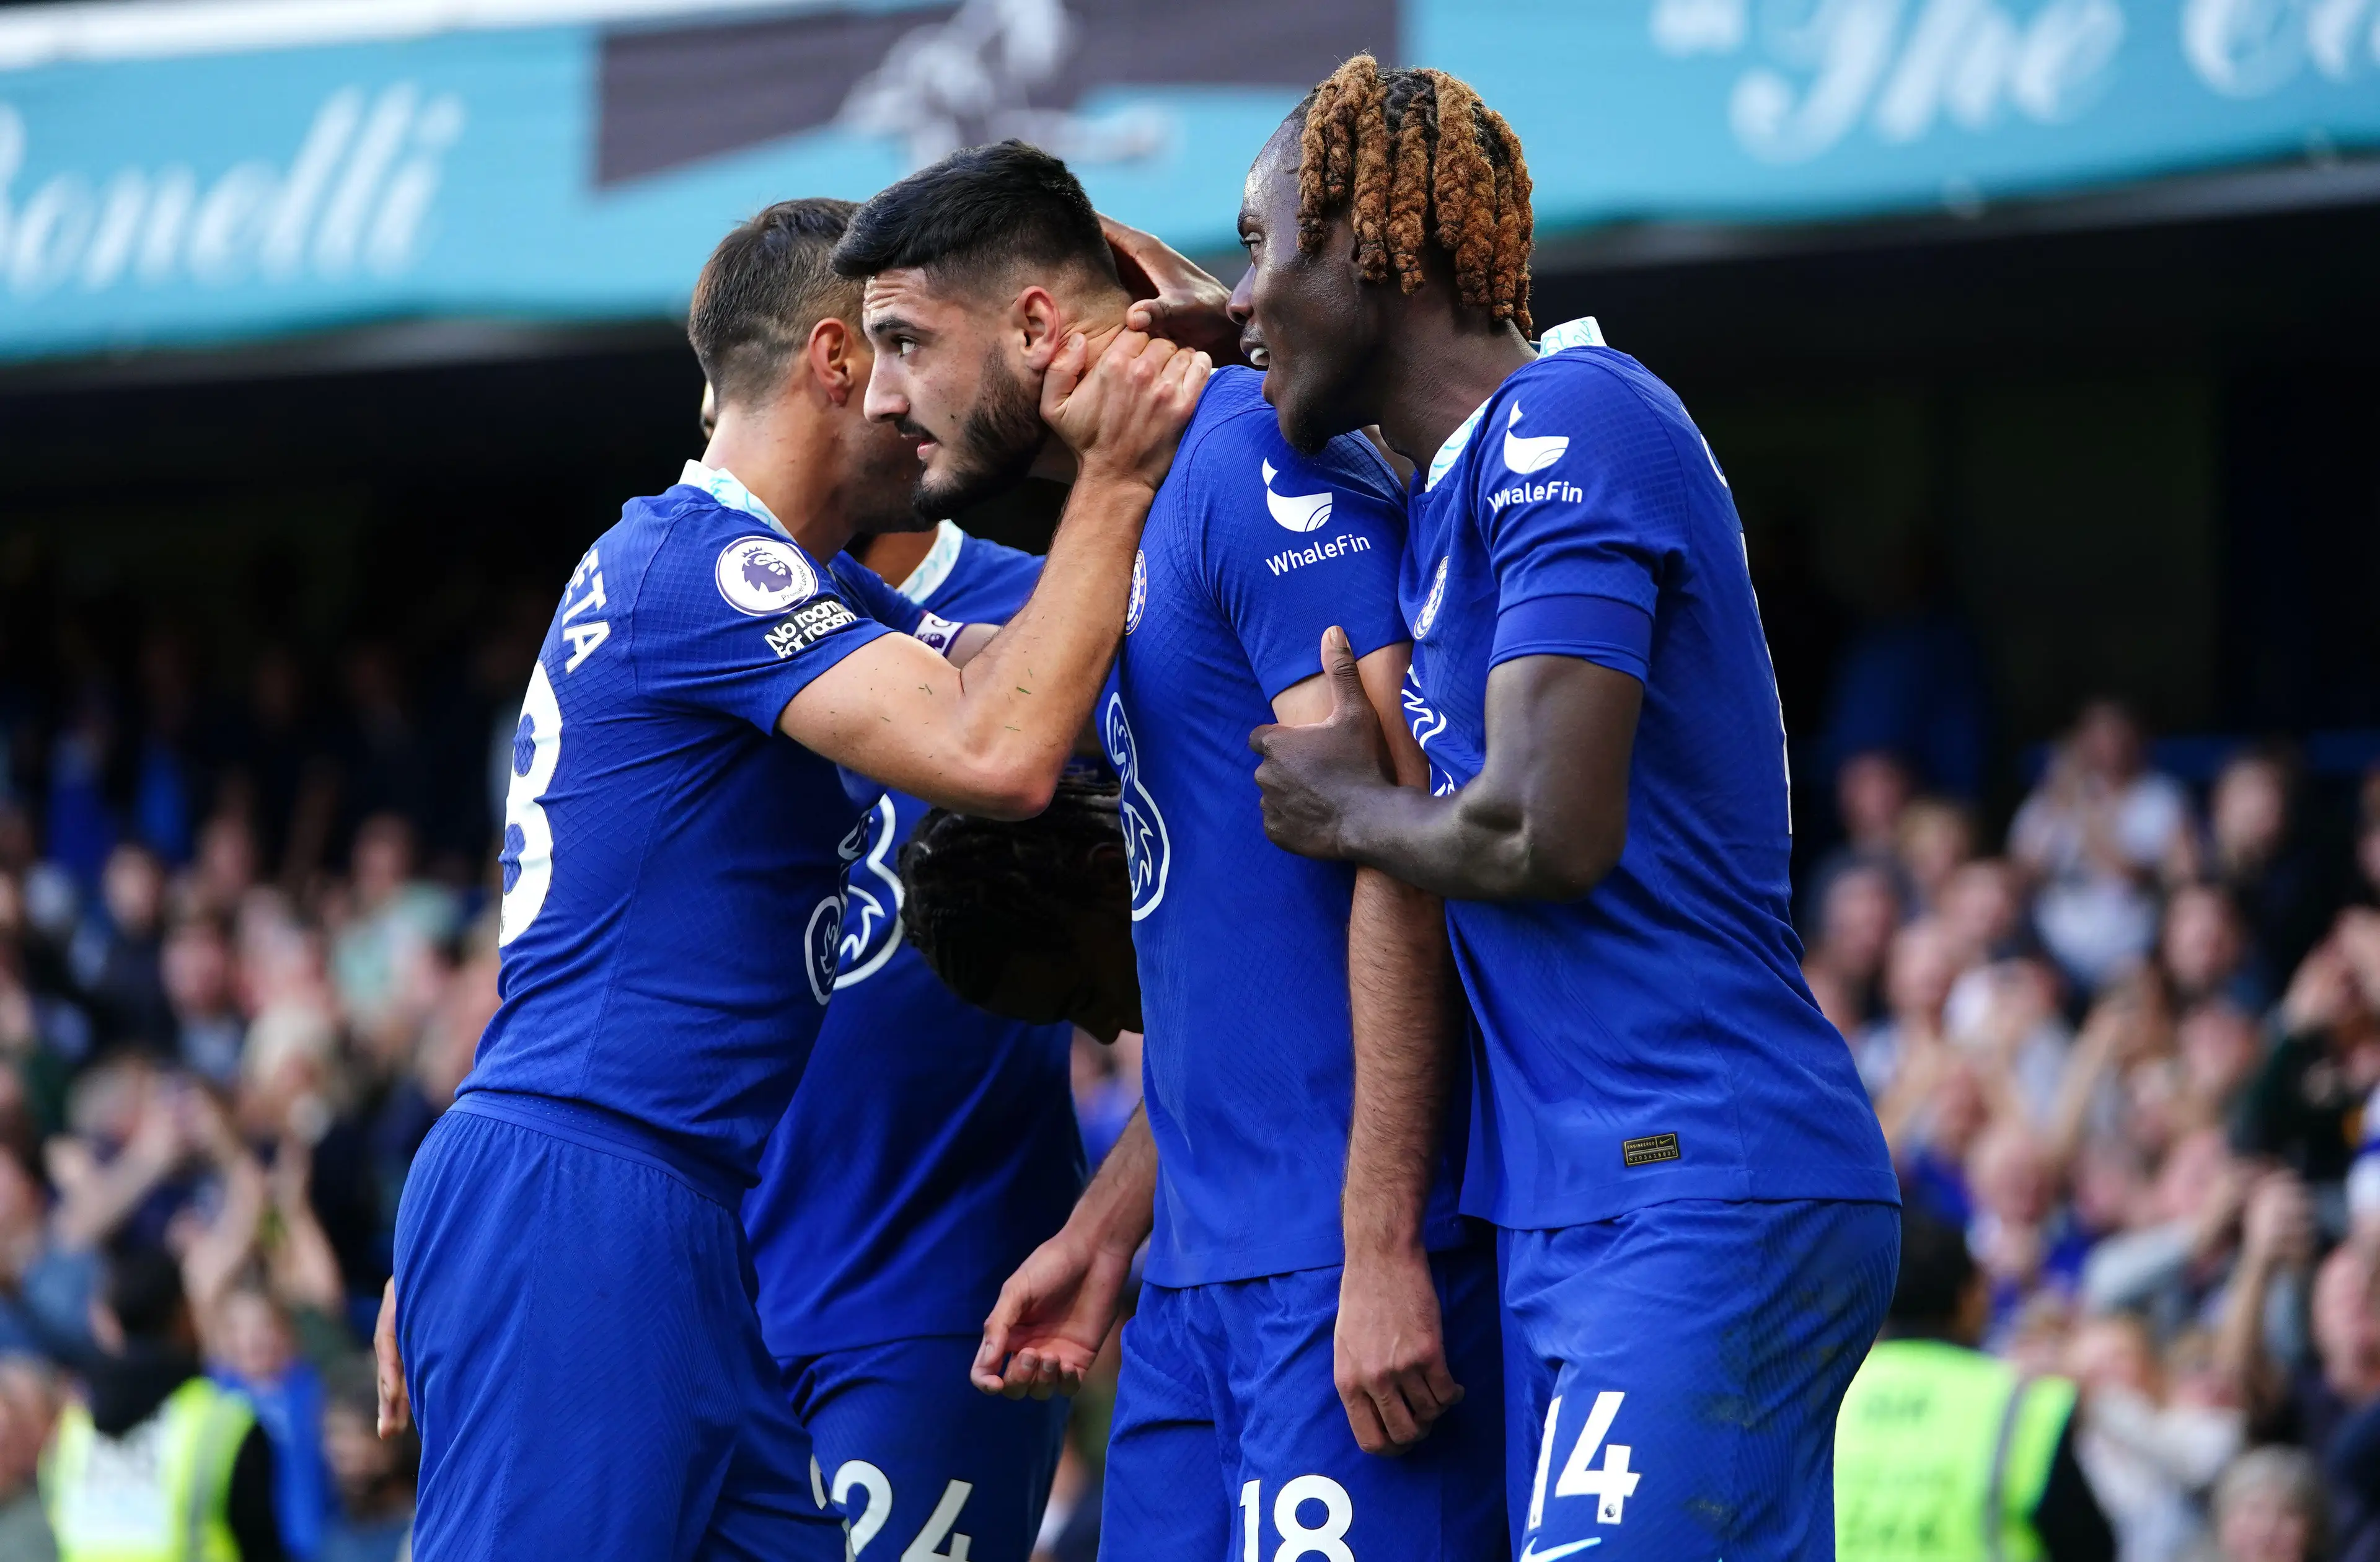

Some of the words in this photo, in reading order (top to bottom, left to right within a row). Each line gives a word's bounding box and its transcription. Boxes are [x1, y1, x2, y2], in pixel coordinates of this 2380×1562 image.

[0, 79, 469, 301] onelli
[1487, 481, 1583, 513] WhaleFin
[1266, 533, 1371, 576] WhaleFin
[764, 622, 797, 651] No
[794, 600, 842, 628] room
[777, 633, 805, 659] for
[803, 611, 857, 642] racism
[1528, 1391, 1641, 1531] 14
[831, 1459, 974, 1562] 24
[1239, 1473, 1355, 1562] 18
